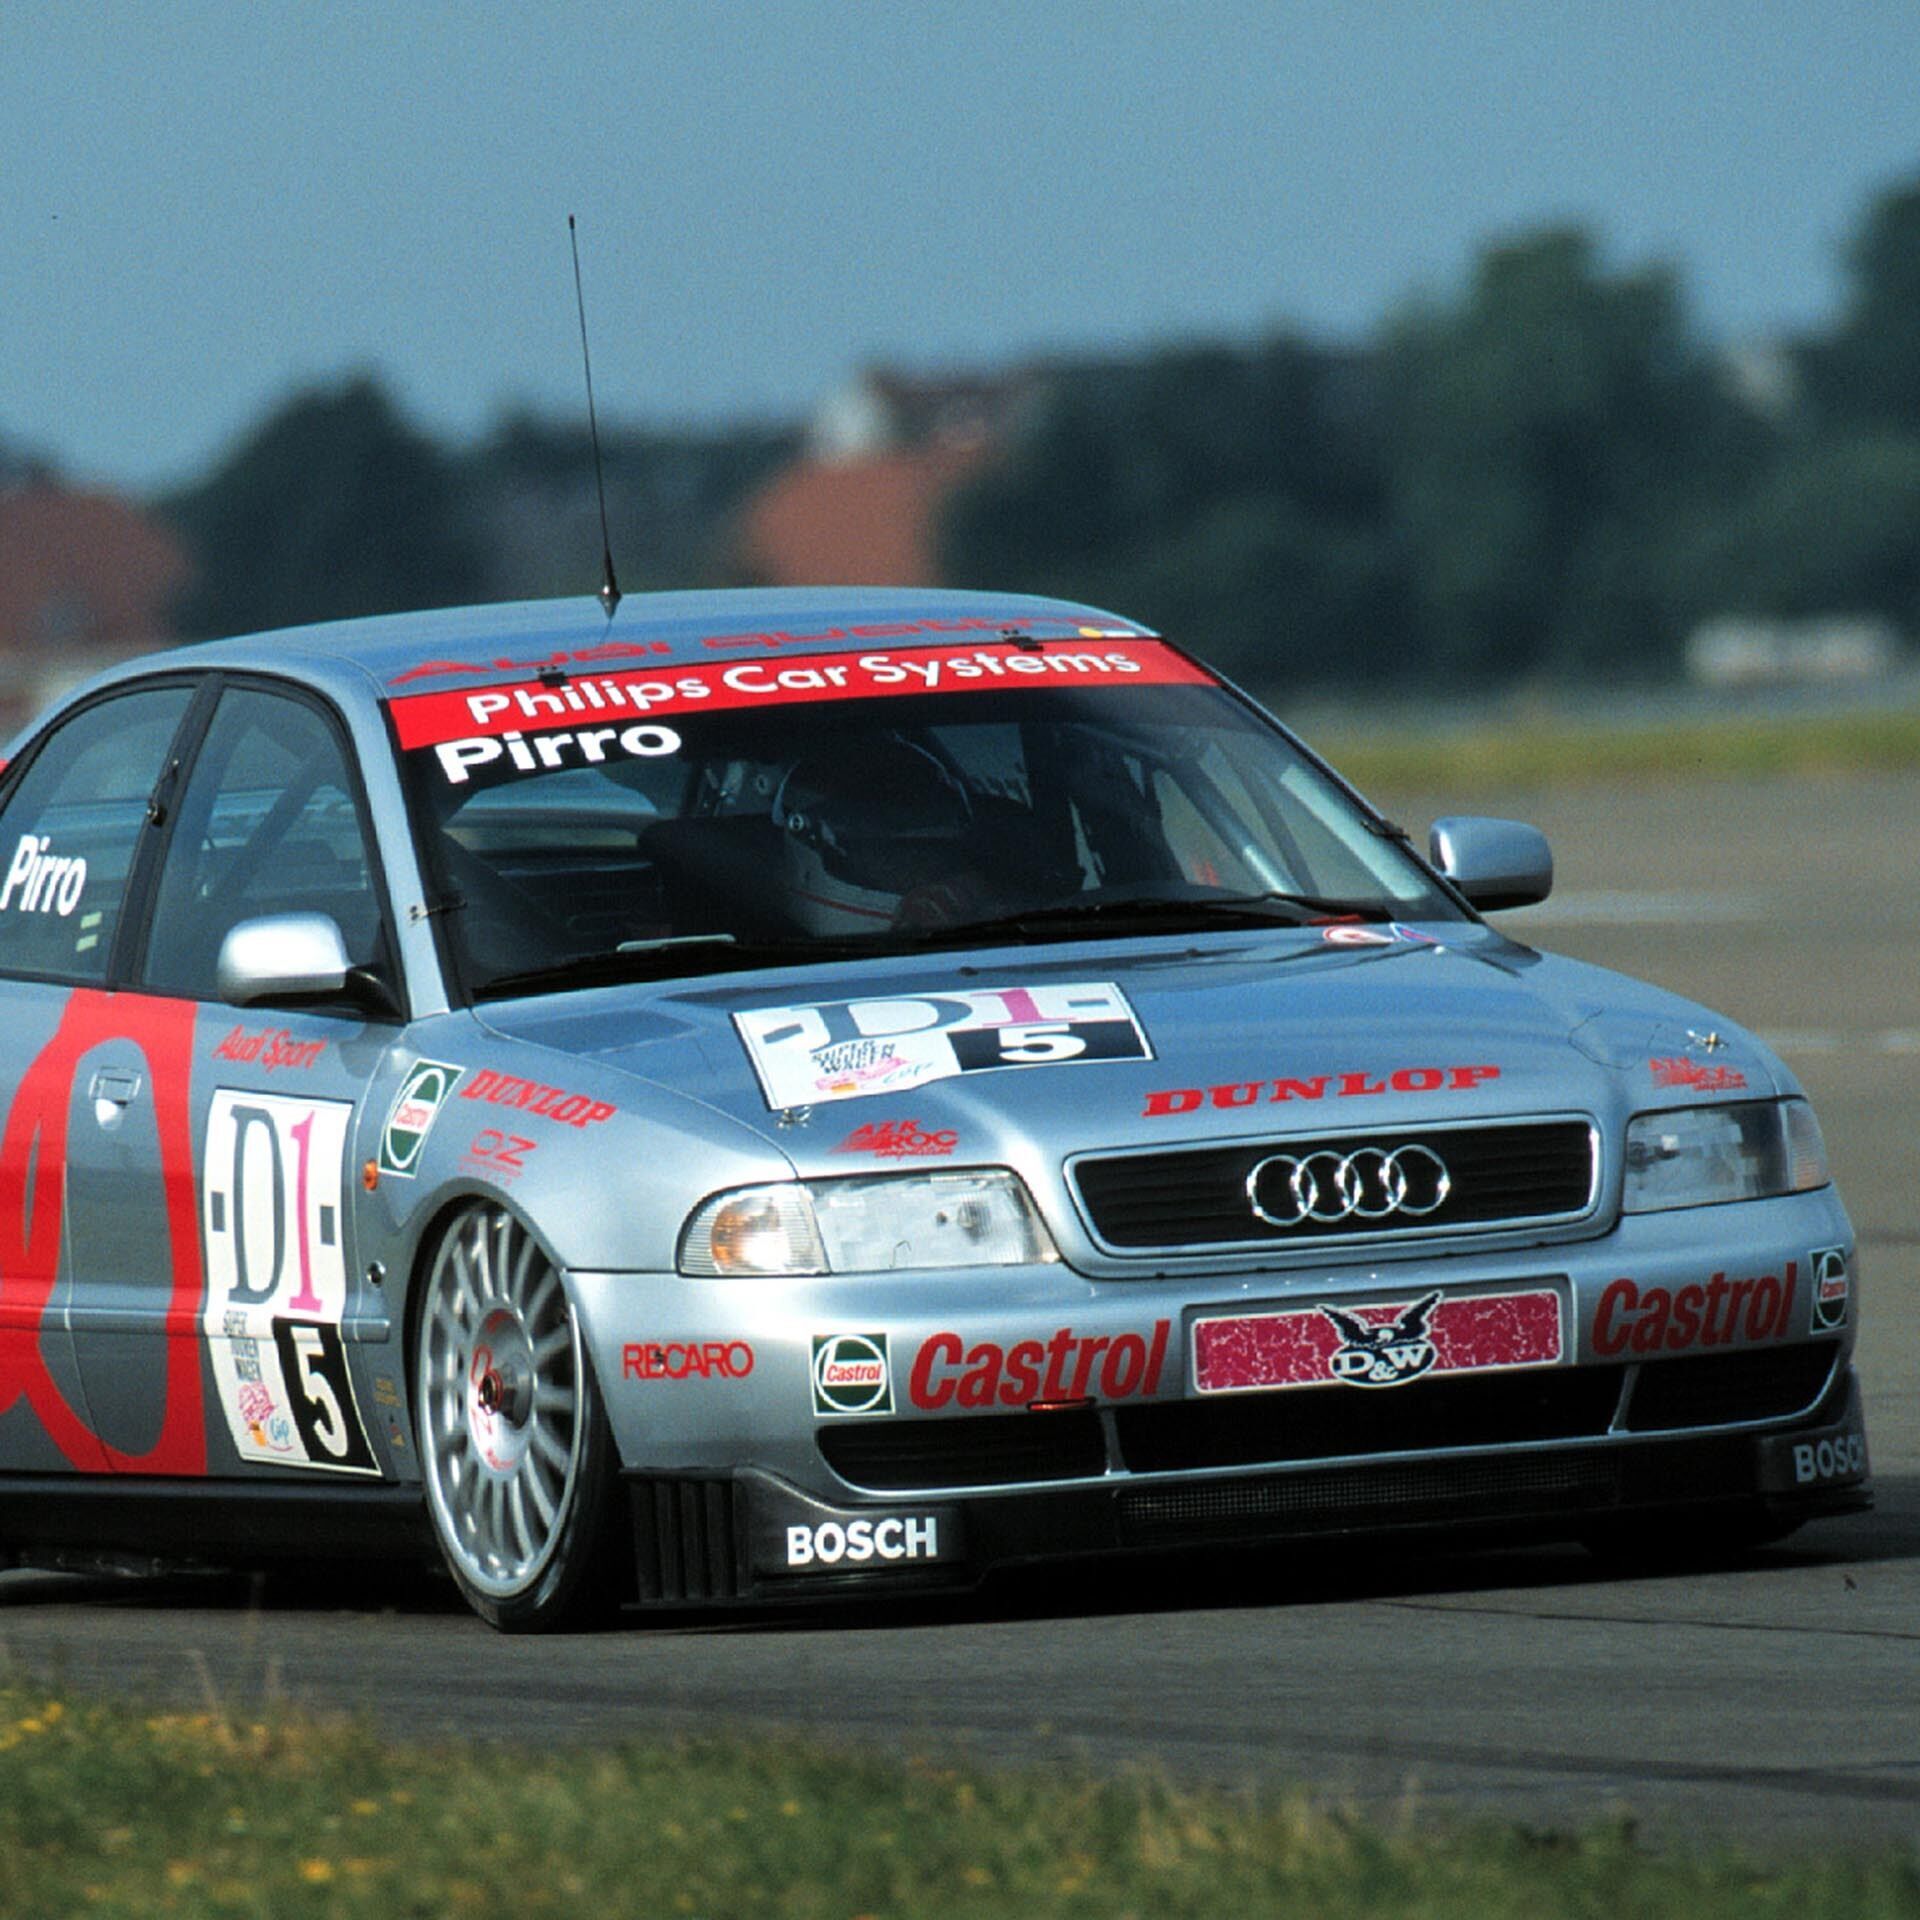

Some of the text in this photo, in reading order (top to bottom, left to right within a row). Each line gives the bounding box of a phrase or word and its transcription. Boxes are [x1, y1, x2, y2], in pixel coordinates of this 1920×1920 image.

[465, 650, 1141, 724] Philips Car Systems
[434, 725, 682, 784] Pirro
[0, 834, 87, 917] Pirro
[261, 1027, 329, 1074] Sport
[998, 1023, 1088, 1063] 5
[459, 1068, 618, 1130] DUNLOP
[1141, 1065, 1501, 1118] DUNLOP
[1591, 1261, 1798, 1356] Castrol
[622, 1339, 755, 1380] RECARO
[826, 1363, 883, 1383] Castrol
[908, 1319, 1171, 1410] Castrol
[1335, 1343, 1430, 1381] D&W
[290, 1325, 348, 1458] 5
[787, 1517, 938, 1565] BOSCH
